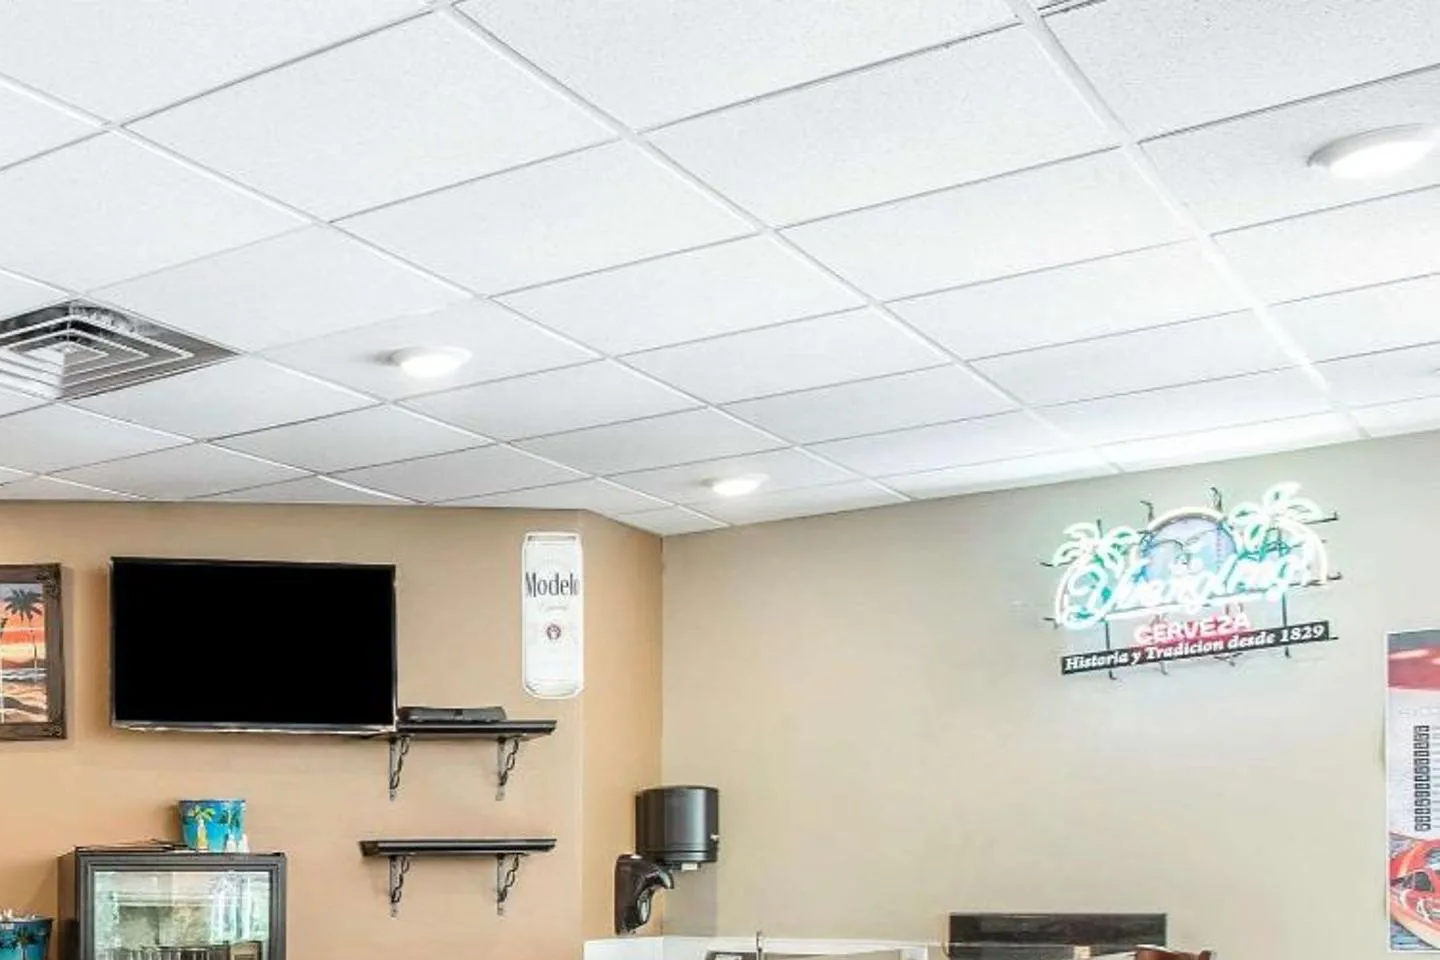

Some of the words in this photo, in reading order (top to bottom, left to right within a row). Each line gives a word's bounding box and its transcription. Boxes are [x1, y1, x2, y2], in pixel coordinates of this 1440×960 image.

[1064, 650, 1128, 671] Historia
[1132, 650, 1141, 665] y
[1146, 641, 1224, 661] Tradicion
[1227, 630, 1275, 649] desde
[1280, 624, 1325, 643] 1829
[1134, 613, 1252, 645] CERVEZA
